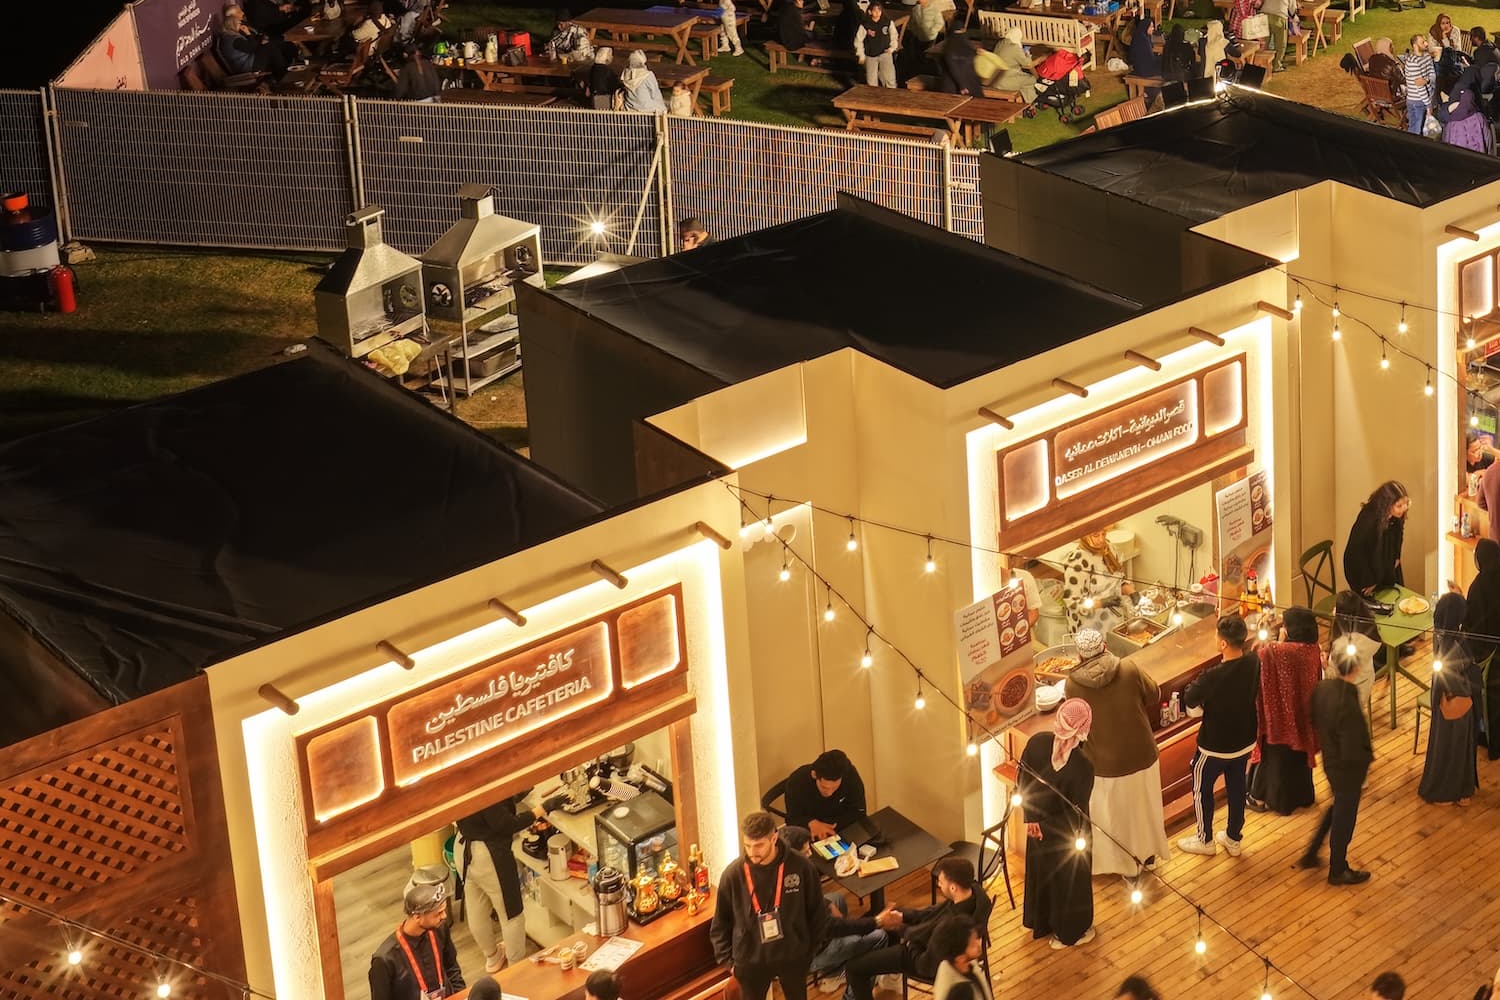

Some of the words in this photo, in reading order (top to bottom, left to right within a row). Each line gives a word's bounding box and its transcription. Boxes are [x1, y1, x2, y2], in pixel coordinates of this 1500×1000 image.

[1084, 463, 1096, 475] AL
[1146, 430, 1173, 448] OMANI
[1173, 421, 1194, 437] FOOD
[510, 649, 575, 697] كافتيريا
[412, 712, 504, 764] PALESTINE
[505, 676, 592, 722] CAFETERIA
[425, 675, 510, 734] فلسطين
